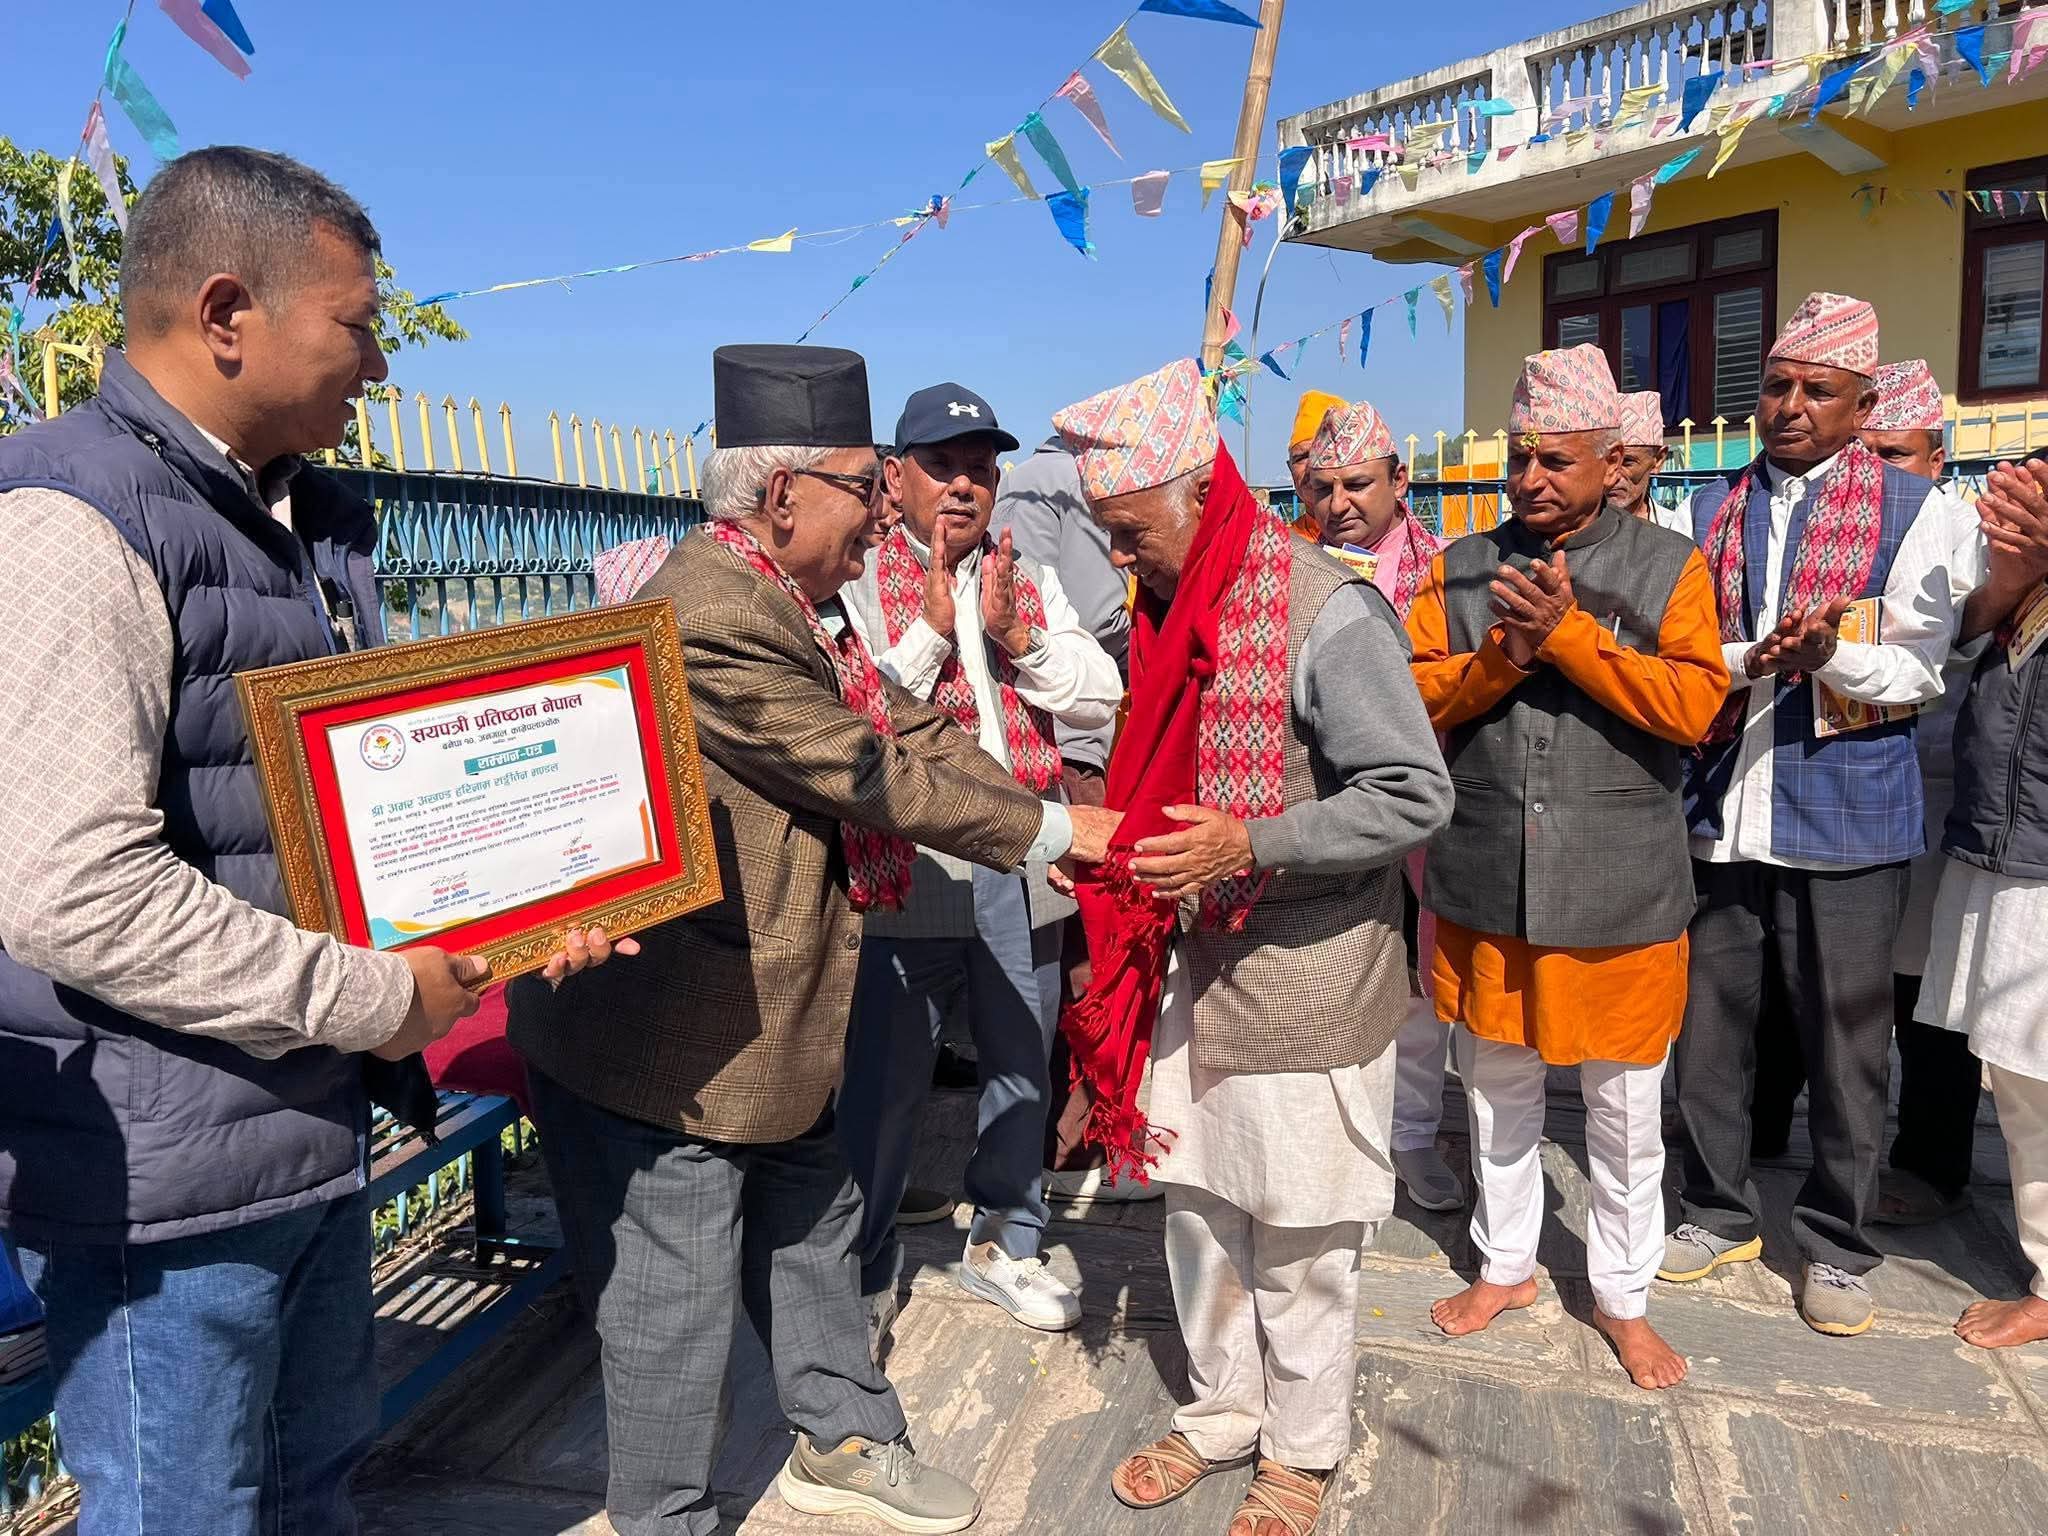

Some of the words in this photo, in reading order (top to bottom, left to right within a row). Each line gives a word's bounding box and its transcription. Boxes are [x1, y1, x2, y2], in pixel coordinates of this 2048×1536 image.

[410, 714, 470, 743] सयपत्री
[474, 703, 538, 731] प्रतिष्ठान
[541, 694, 583, 714] नेपाल
[442, 739, 463, 750] बनेपा
[371, 804, 385, 817] श्री
[388, 799, 414, 814] अमर
[417, 790, 452, 806] अखण्ड
[455, 779, 491, 797] हरिनाम
[531, 763, 559, 778] मण्डल
